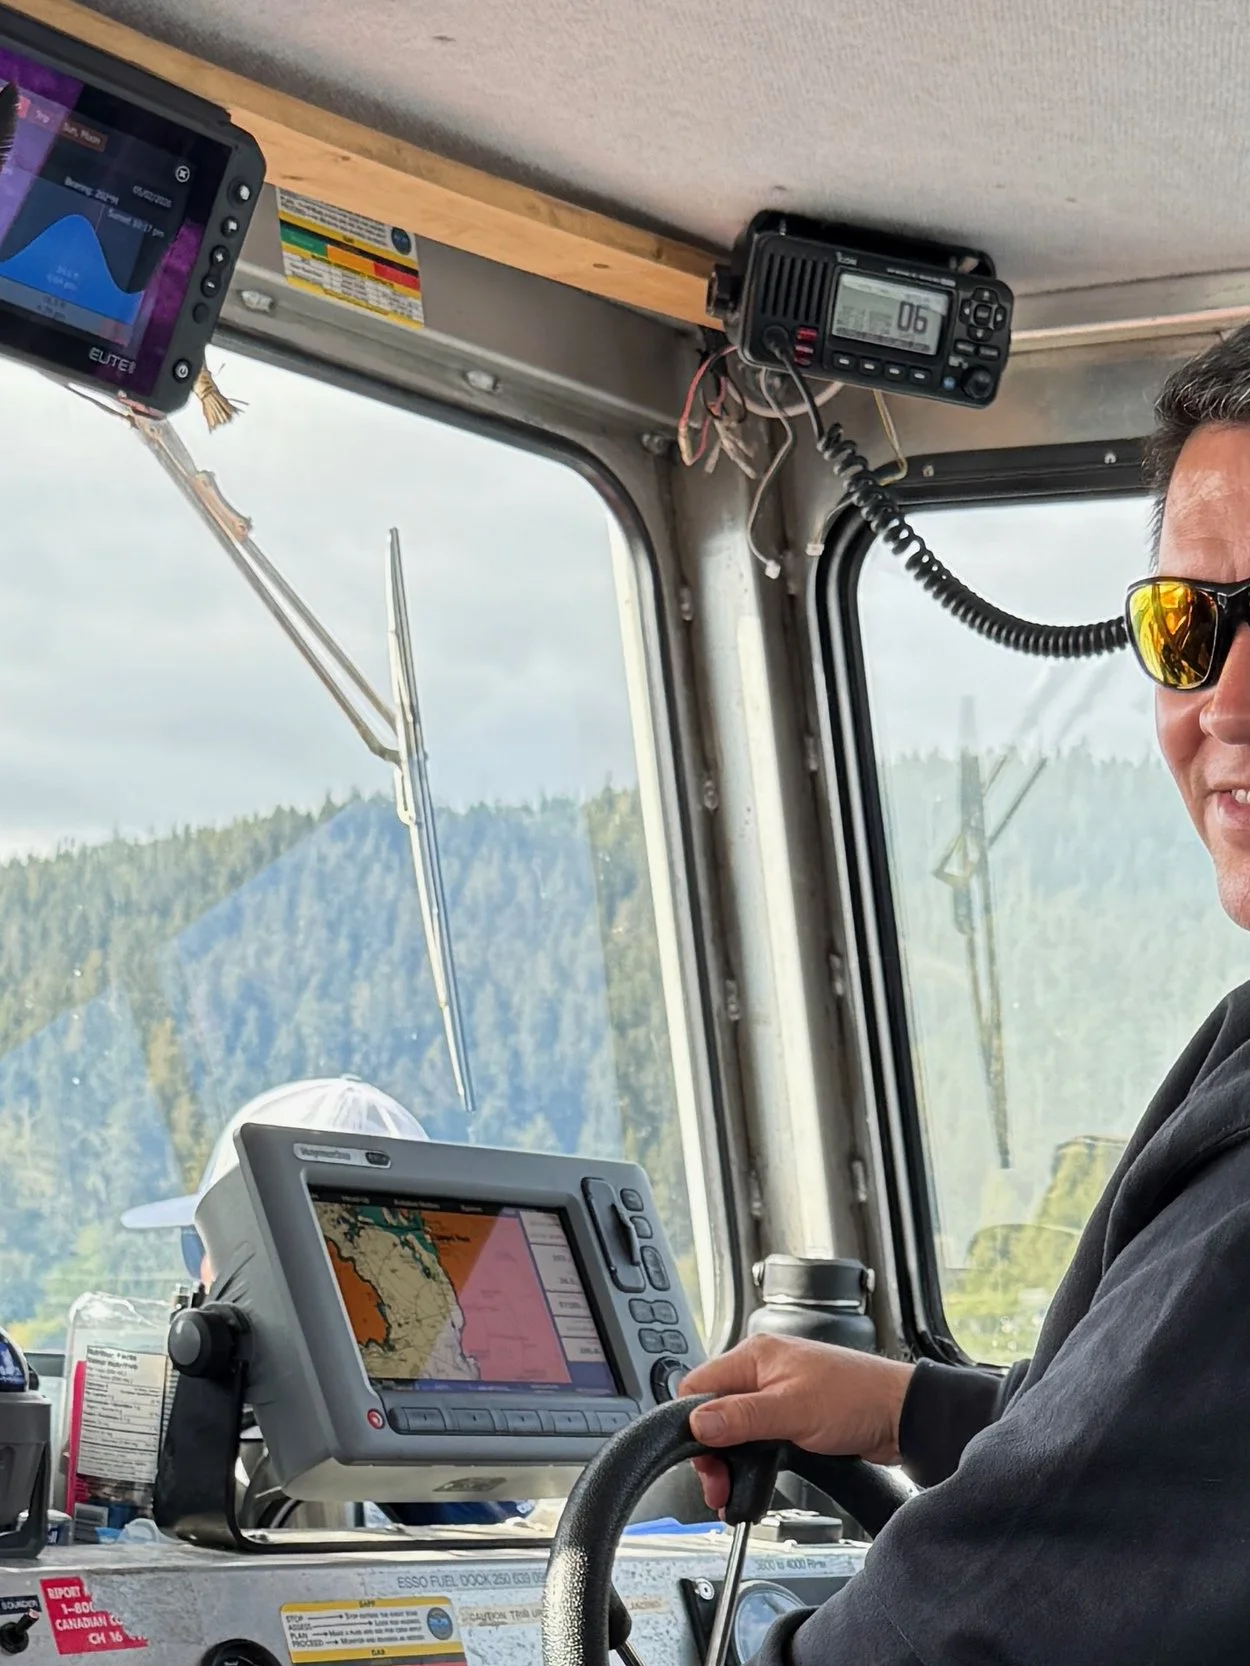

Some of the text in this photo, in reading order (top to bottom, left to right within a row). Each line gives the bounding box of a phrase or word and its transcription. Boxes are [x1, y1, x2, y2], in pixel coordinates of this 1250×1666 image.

[397, 1575, 429, 1590] ESSO
[430, 1574, 459, 1588] FUEL
[459, 1573, 493, 1587] DOCK
[47, 1586, 81, 1599] REPORT
[55, 1615, 108, 1631] CANADIAN
[88, 1633, 106, 1645] CH
[109, 1631, 123, 1643] 16
